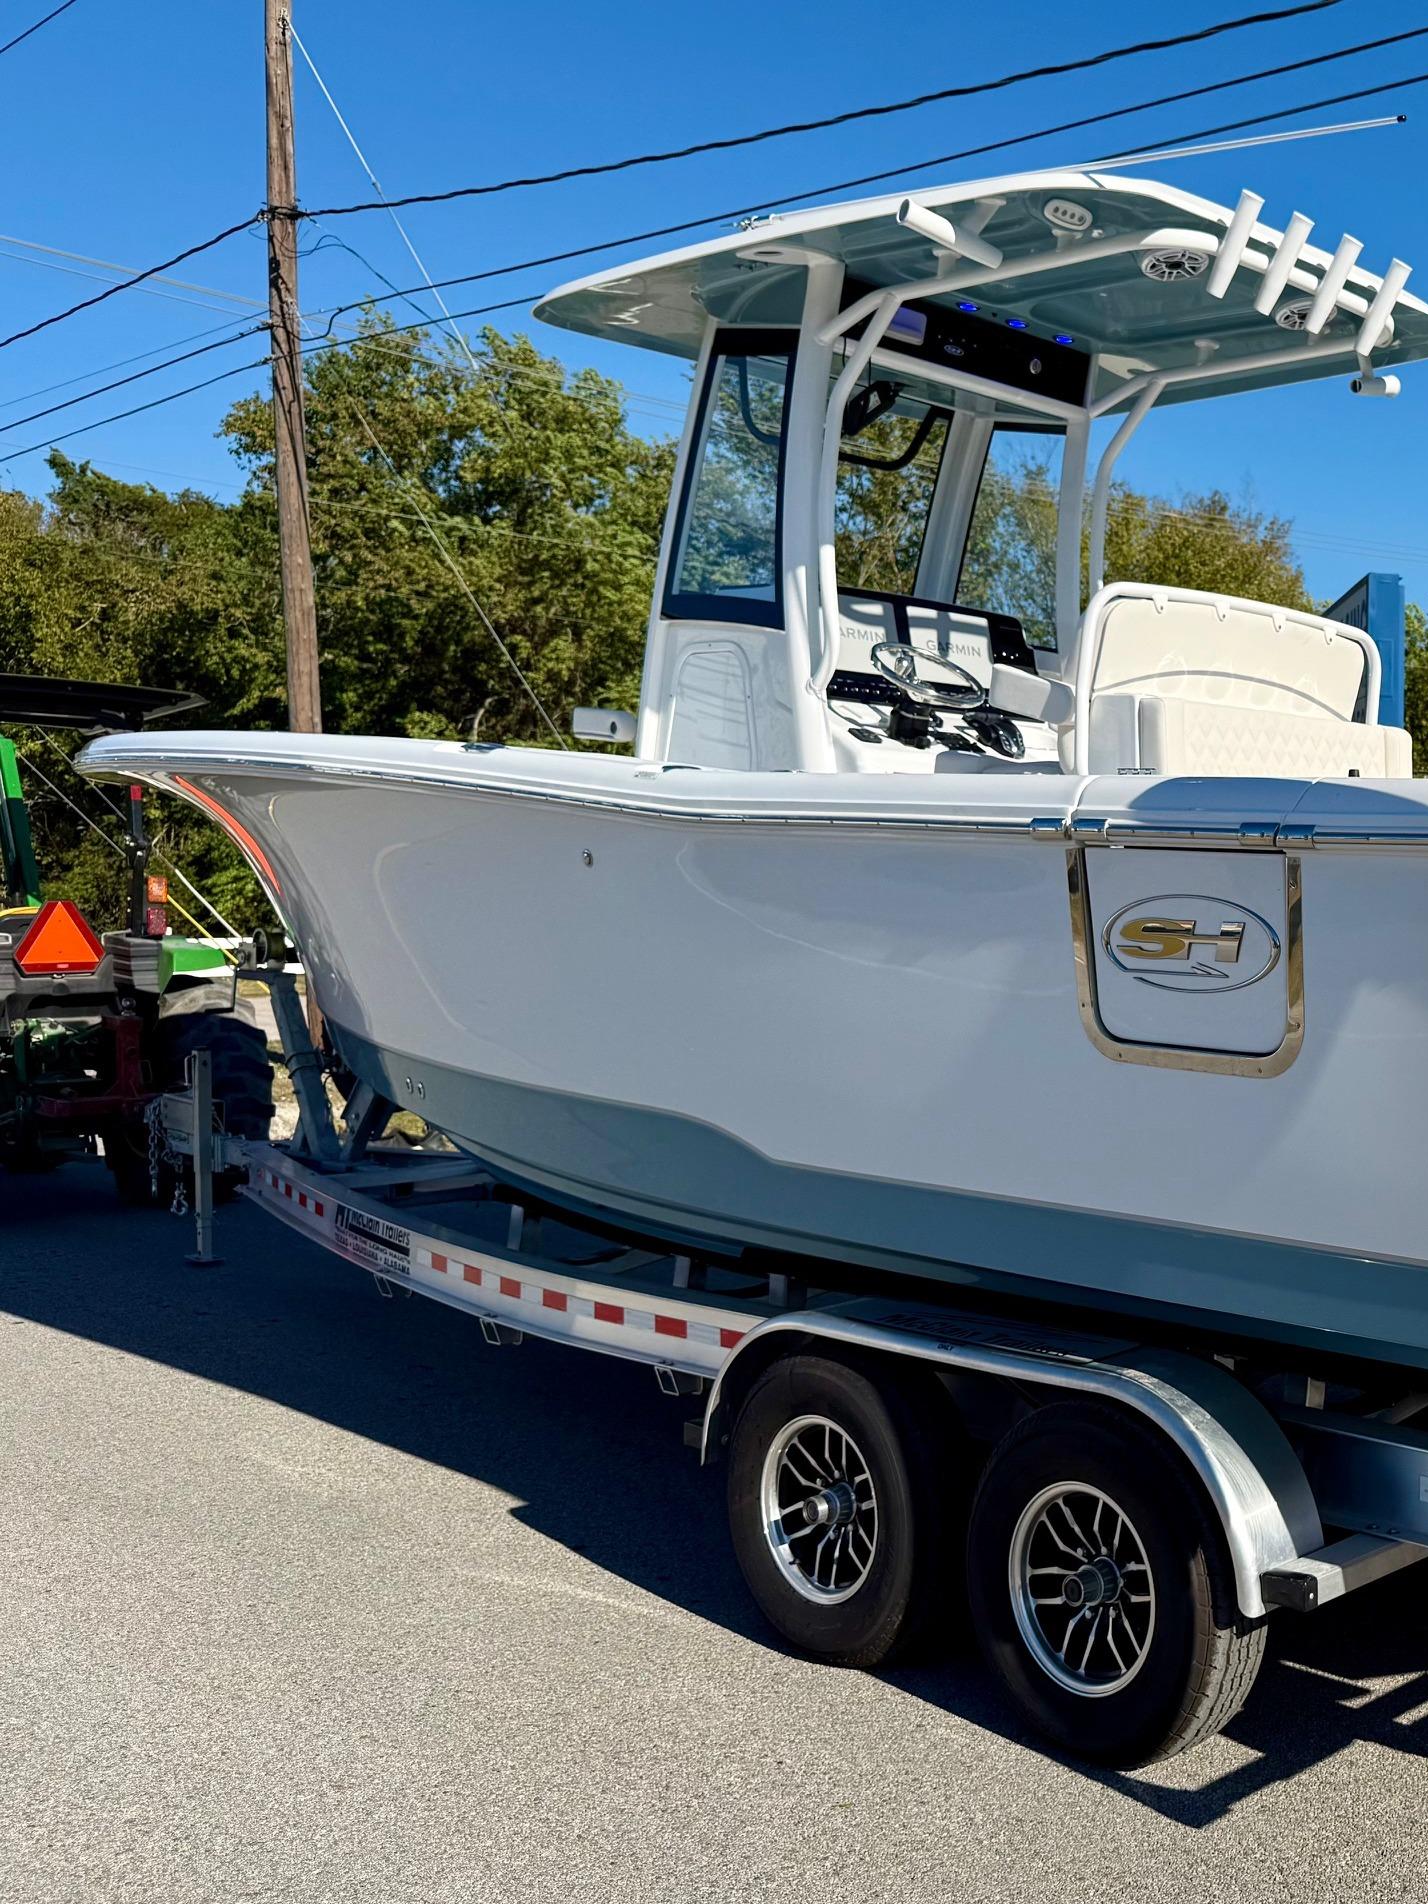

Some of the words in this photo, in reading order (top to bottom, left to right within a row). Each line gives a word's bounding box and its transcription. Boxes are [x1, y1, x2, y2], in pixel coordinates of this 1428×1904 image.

[839, 626, 885, 643] ARMIN
[926, 639, 982, 658] GARMIN
[1117, 917, 1247, 963] SH
[381, 1221, 411, 1246] Trailers
